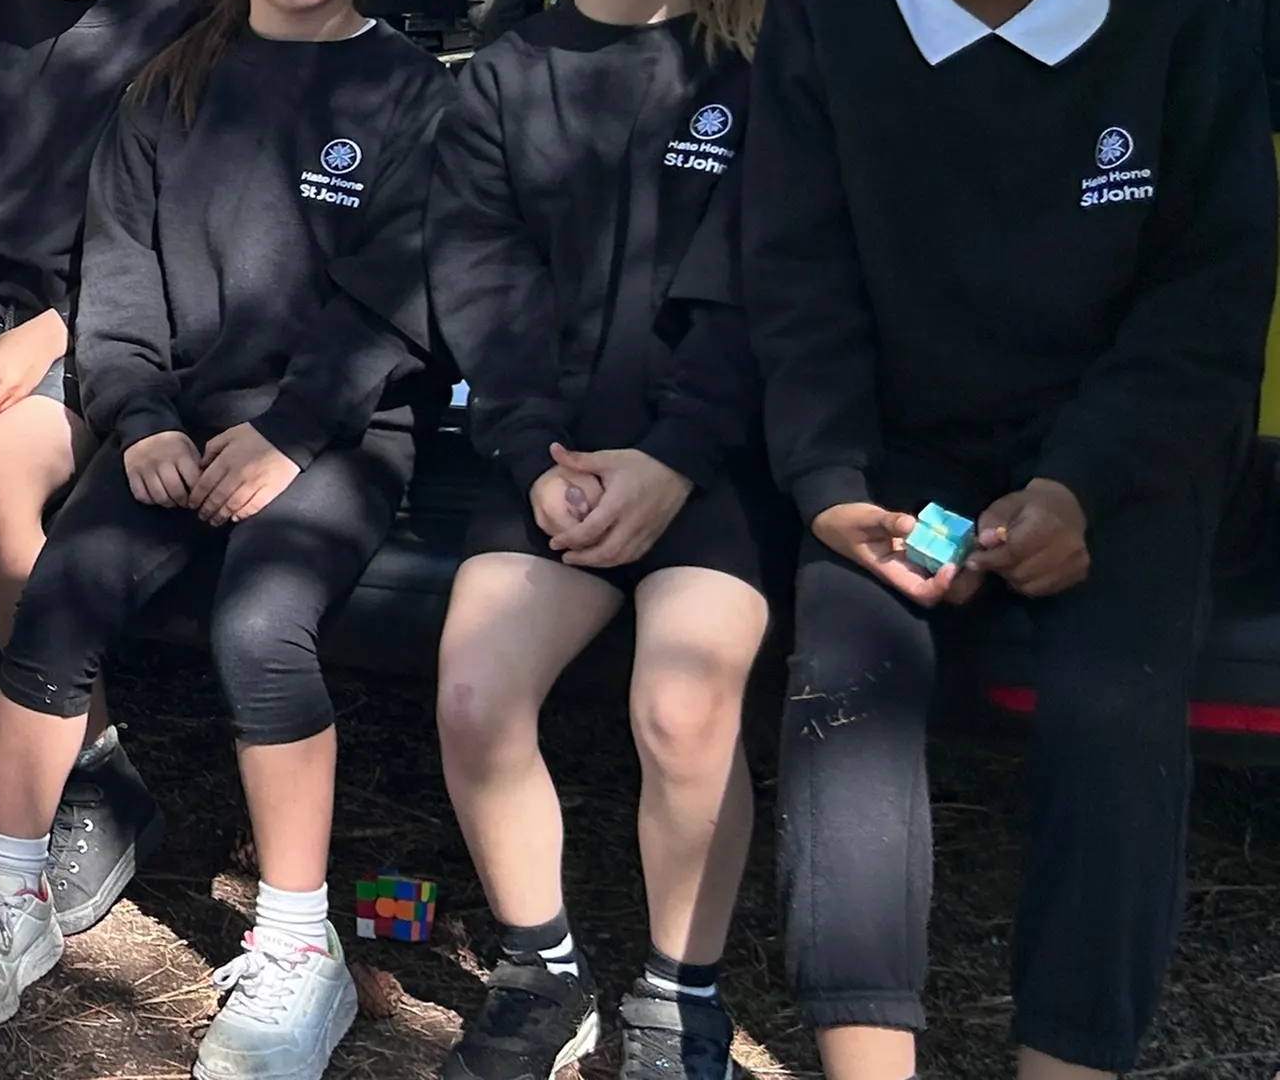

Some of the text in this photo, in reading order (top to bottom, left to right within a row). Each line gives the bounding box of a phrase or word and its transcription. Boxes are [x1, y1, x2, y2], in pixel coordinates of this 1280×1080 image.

[663, 153, 684, 167] St
[300, 184, 360, 208] St John
[1080, 185, 1153, 206] St John
